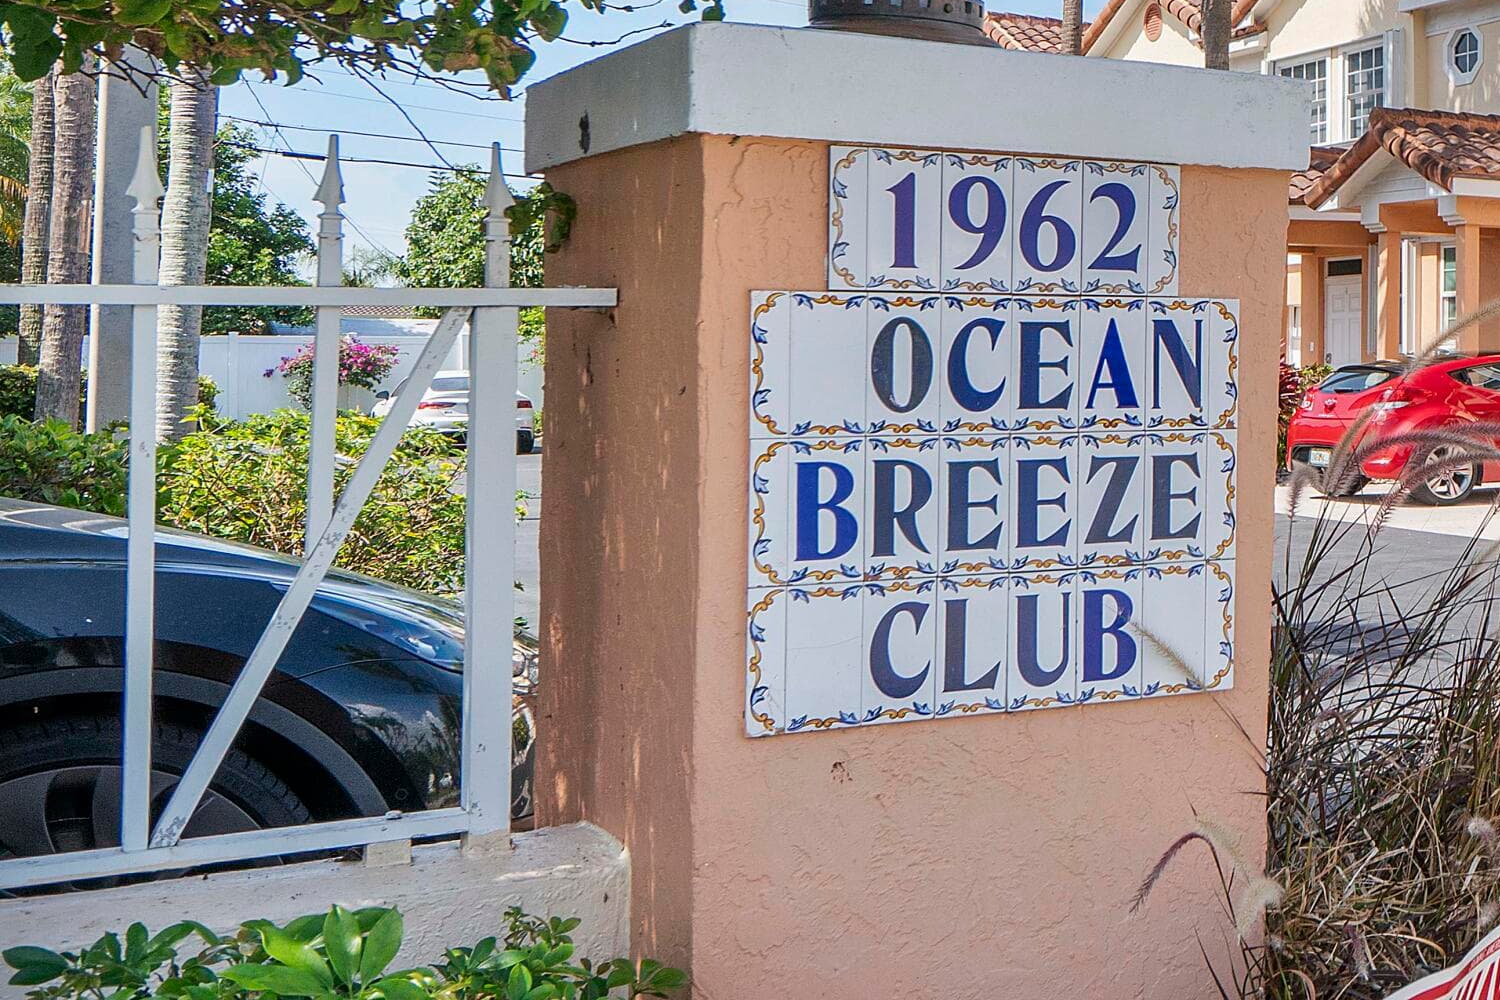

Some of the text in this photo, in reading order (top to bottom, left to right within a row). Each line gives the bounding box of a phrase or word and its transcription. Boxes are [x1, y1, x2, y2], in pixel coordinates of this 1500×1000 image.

[885, 172, 1142, 274] 1962
[870, 316, 1204, 414] OCEAN
[794, 451, 1202, 562] BREEZE
[869, 589, 1137, 699] CLUB
